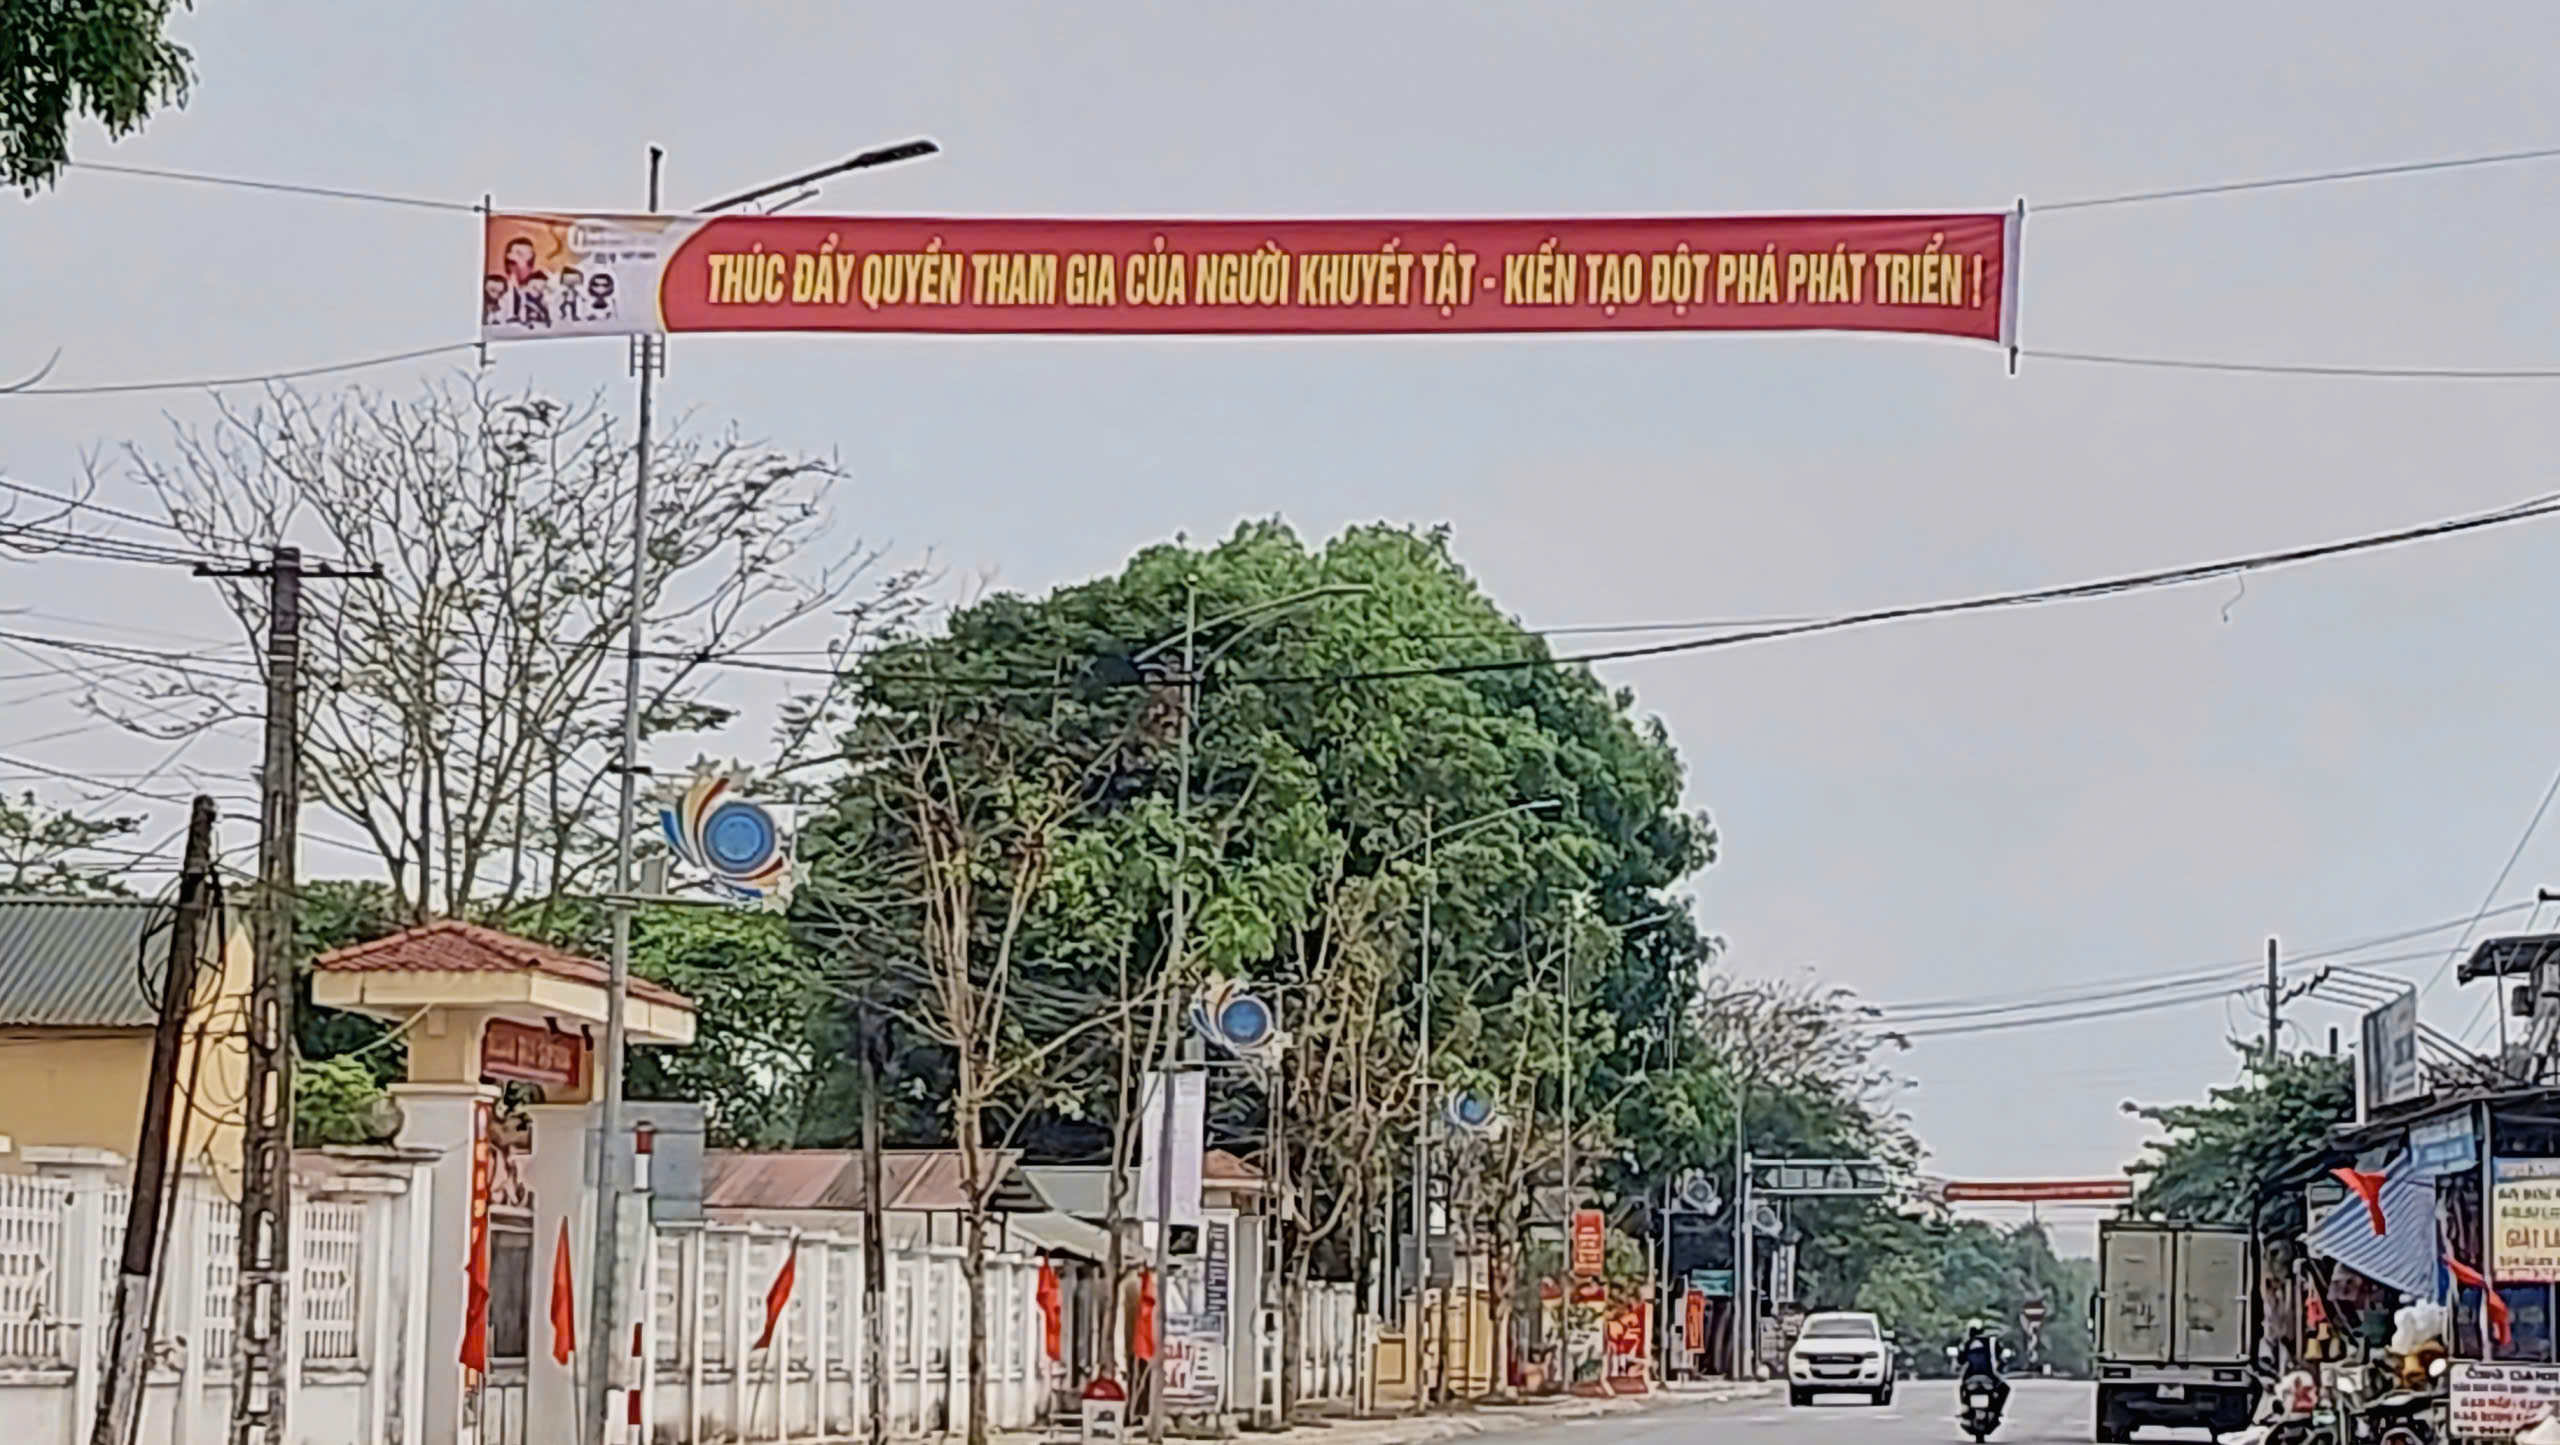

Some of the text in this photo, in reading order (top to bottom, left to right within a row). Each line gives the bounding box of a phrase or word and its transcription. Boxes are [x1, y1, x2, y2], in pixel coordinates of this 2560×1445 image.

[708, 231, 1984, 317] THÚC ĐẨY QUYỀN THAM GIA CỦA NGƯỜI KHUYẾT TẬT - KIẾN TẠO ĐỘT PHÁ PHÁT TRIỂN !
